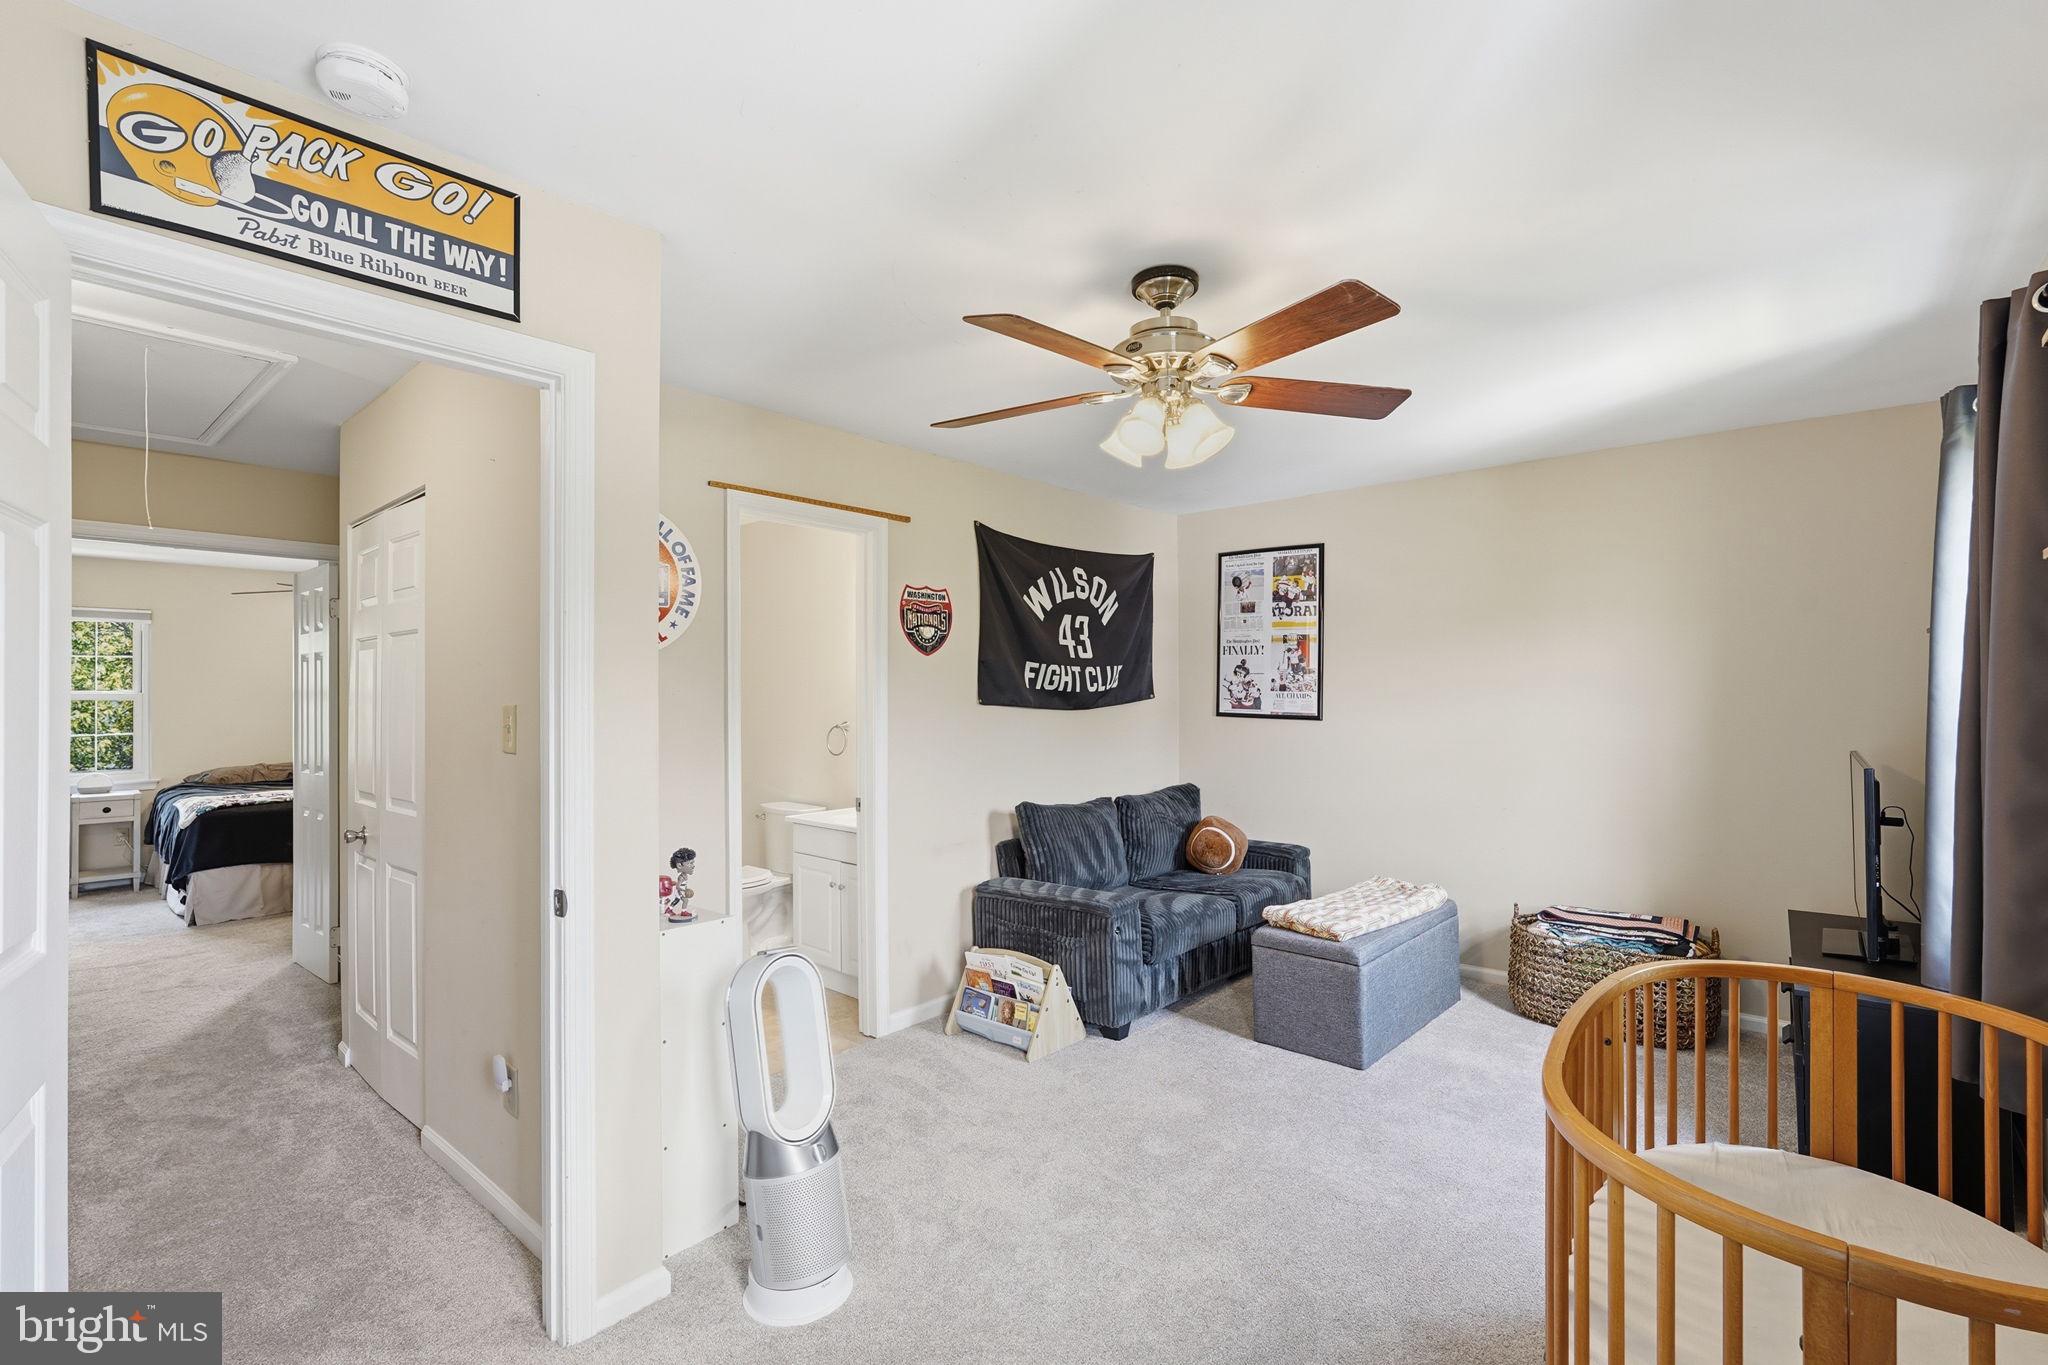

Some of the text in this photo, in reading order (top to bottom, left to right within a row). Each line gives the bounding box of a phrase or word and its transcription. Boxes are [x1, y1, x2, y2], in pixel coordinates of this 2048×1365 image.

[117, 112, 494, 225] GO PACK GO!
[236, 216, 469, 298] Pabst Blue Ribbon BEER
[290, 194, 508, 282] GO ALL THE WAY!
[671, 541, 693, 565] OF
[675, 566, 697, 620] FAME
[906, 590, 946, 602] WASHINGTON
[1022, 566, 1119, 627] WILSON
[907, 611, 946, 630] NATIONALS
[1058, 614, 1094, 659] 43
[1222, 645, 1265, 656] FINALLY!
[1024, 660, 1080, 693] FIGHT
